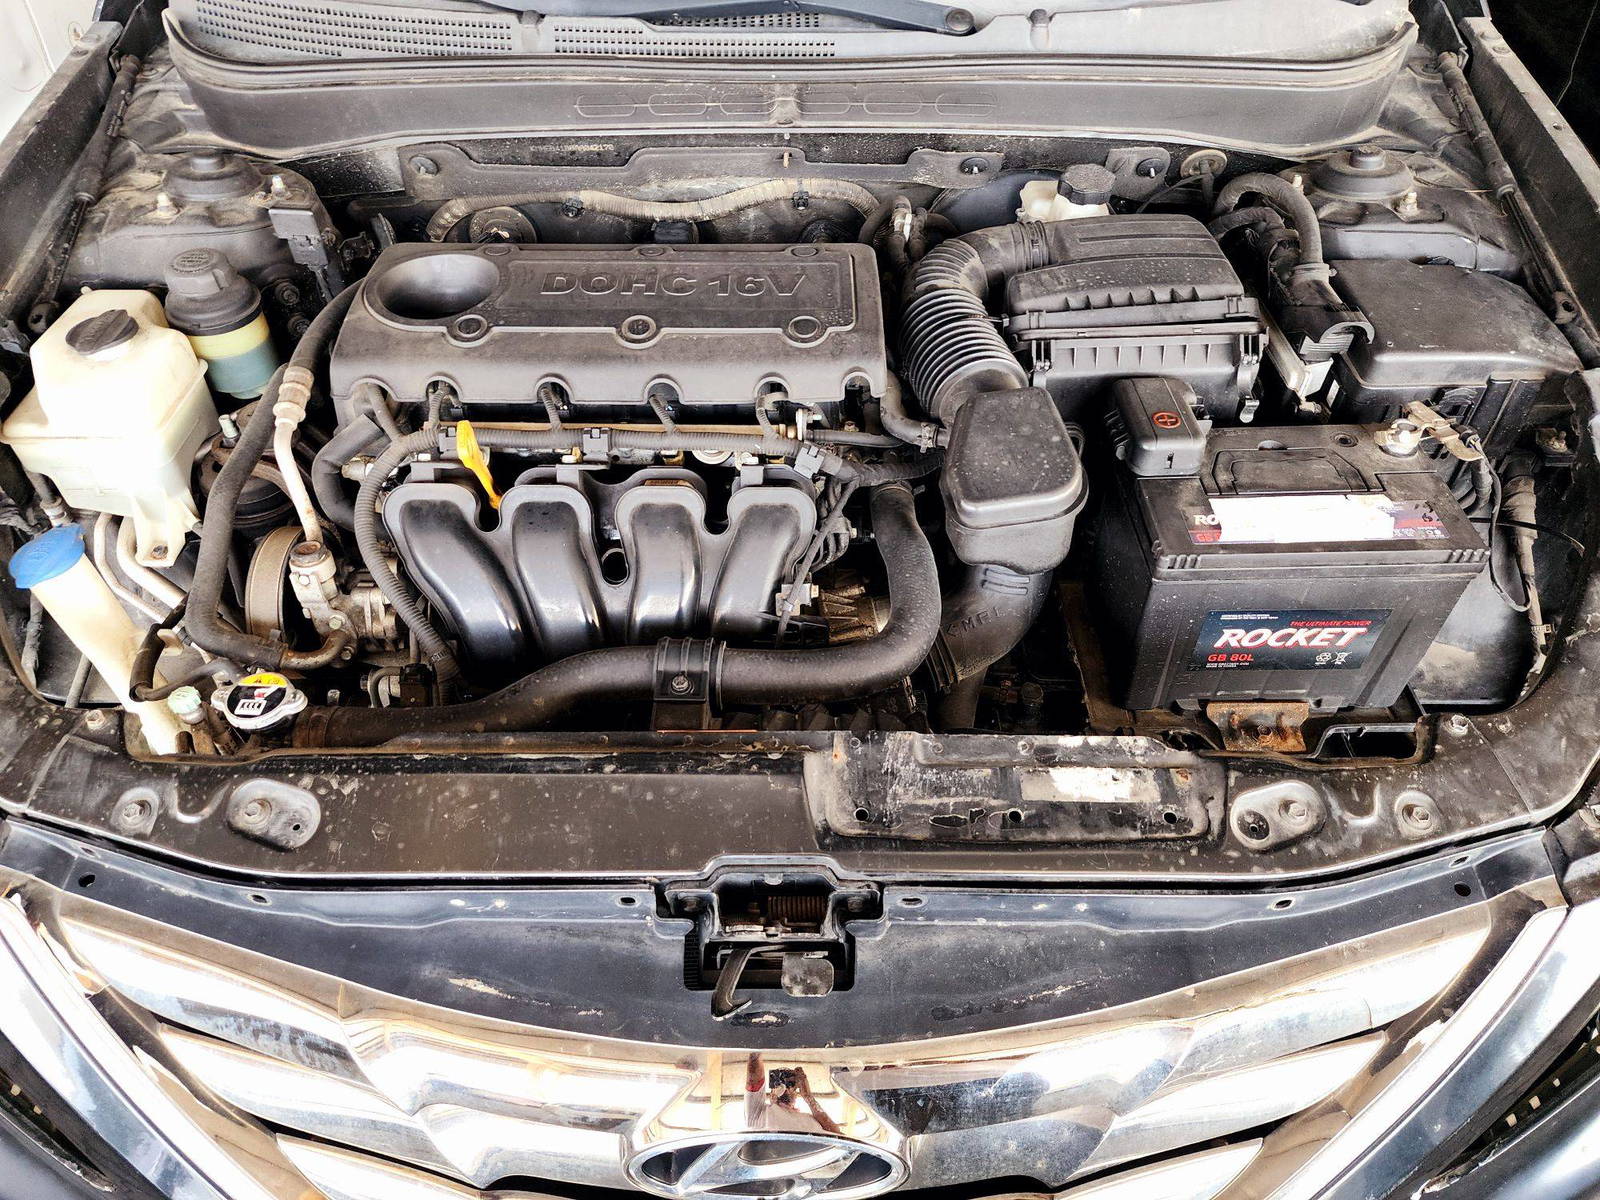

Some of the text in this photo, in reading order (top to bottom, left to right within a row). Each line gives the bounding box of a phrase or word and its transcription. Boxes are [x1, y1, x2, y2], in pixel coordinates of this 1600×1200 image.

[540, 271, 806, 296] DOHC 16V
[1213, 627, 1368, 650] ROCKET
[1207, 653, 1255, 662] GB 80L
